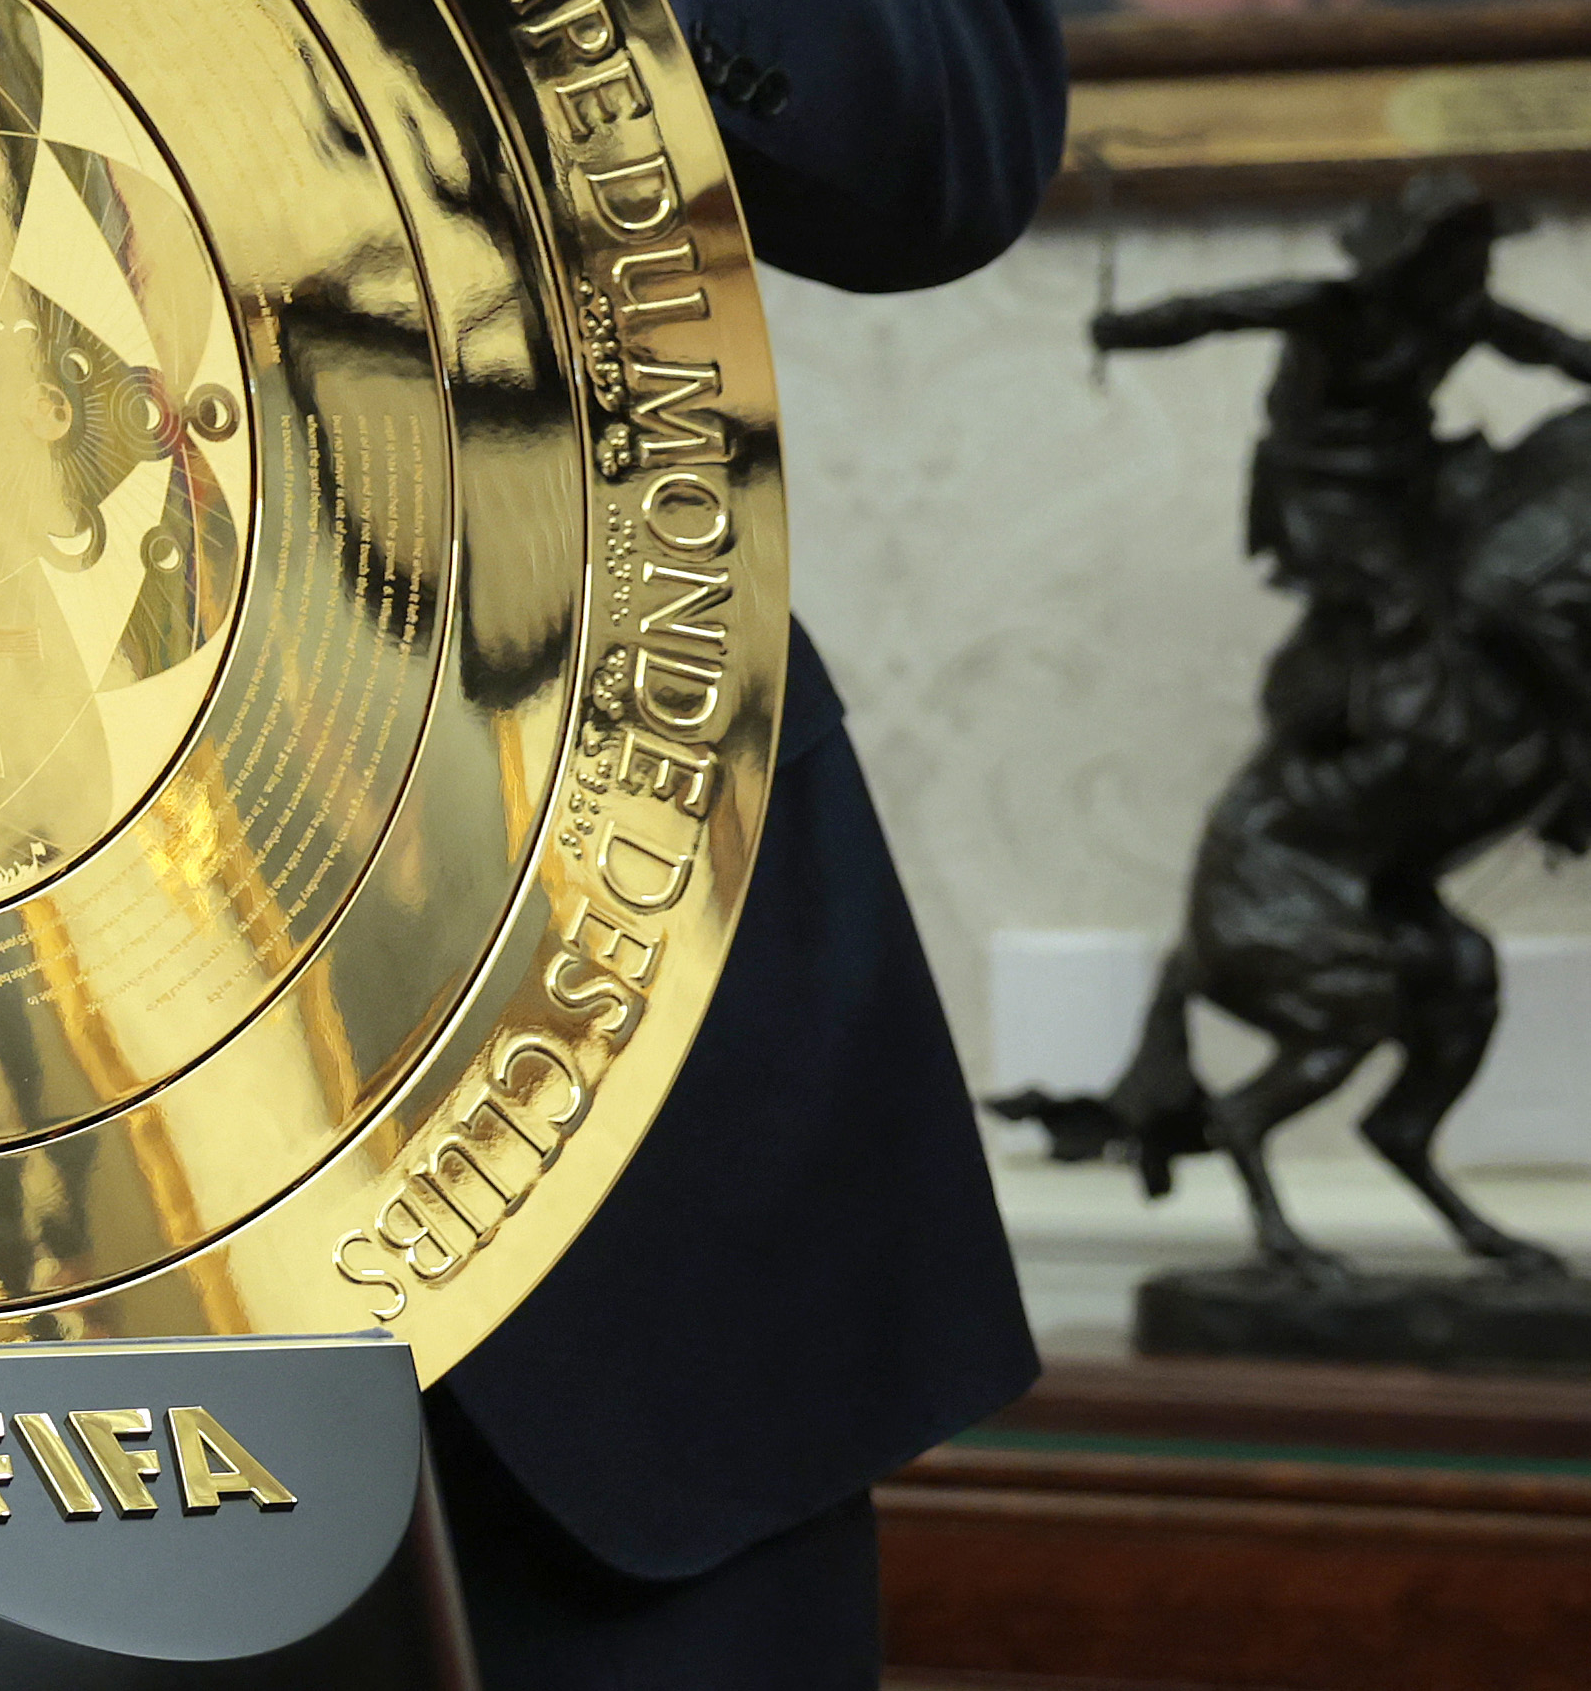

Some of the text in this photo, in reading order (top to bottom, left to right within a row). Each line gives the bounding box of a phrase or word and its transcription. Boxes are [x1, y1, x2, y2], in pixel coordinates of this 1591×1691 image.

[585, 155, 711, 323] DU
[619, 362, 733, 818] MONDE
[545, 820, 695, 1036] DES
[332, 1035, 586, 1321] CLUBS
